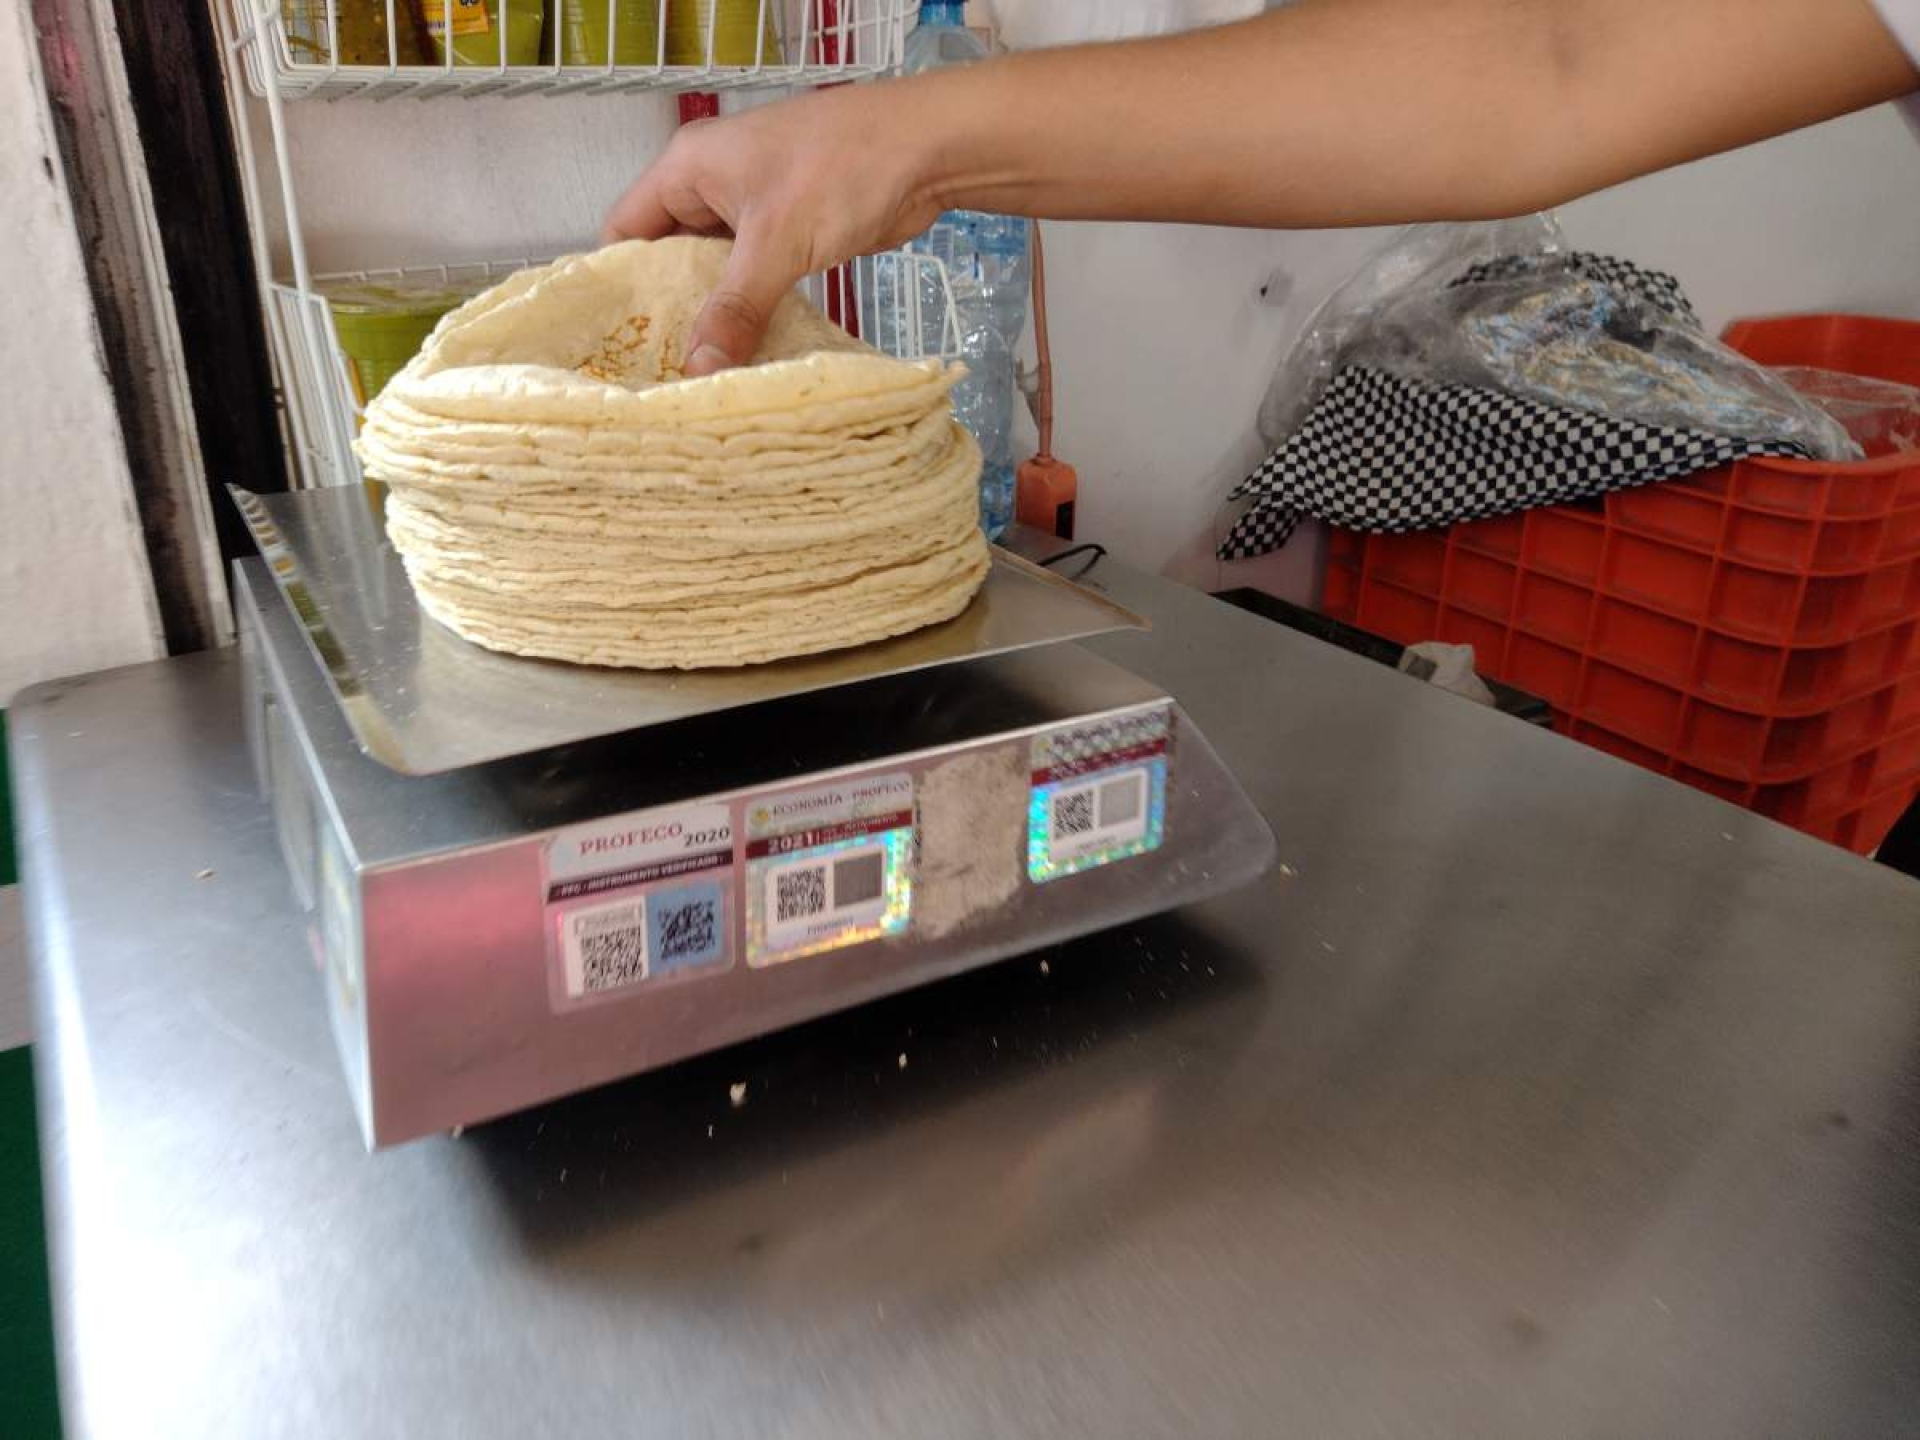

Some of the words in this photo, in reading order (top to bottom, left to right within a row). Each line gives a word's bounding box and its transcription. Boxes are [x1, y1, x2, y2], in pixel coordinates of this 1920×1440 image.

[579, 823, 683, 856] PROFECO
[684, 825, 731, 848] 2020
[768, 831, 811, 854] 2021
